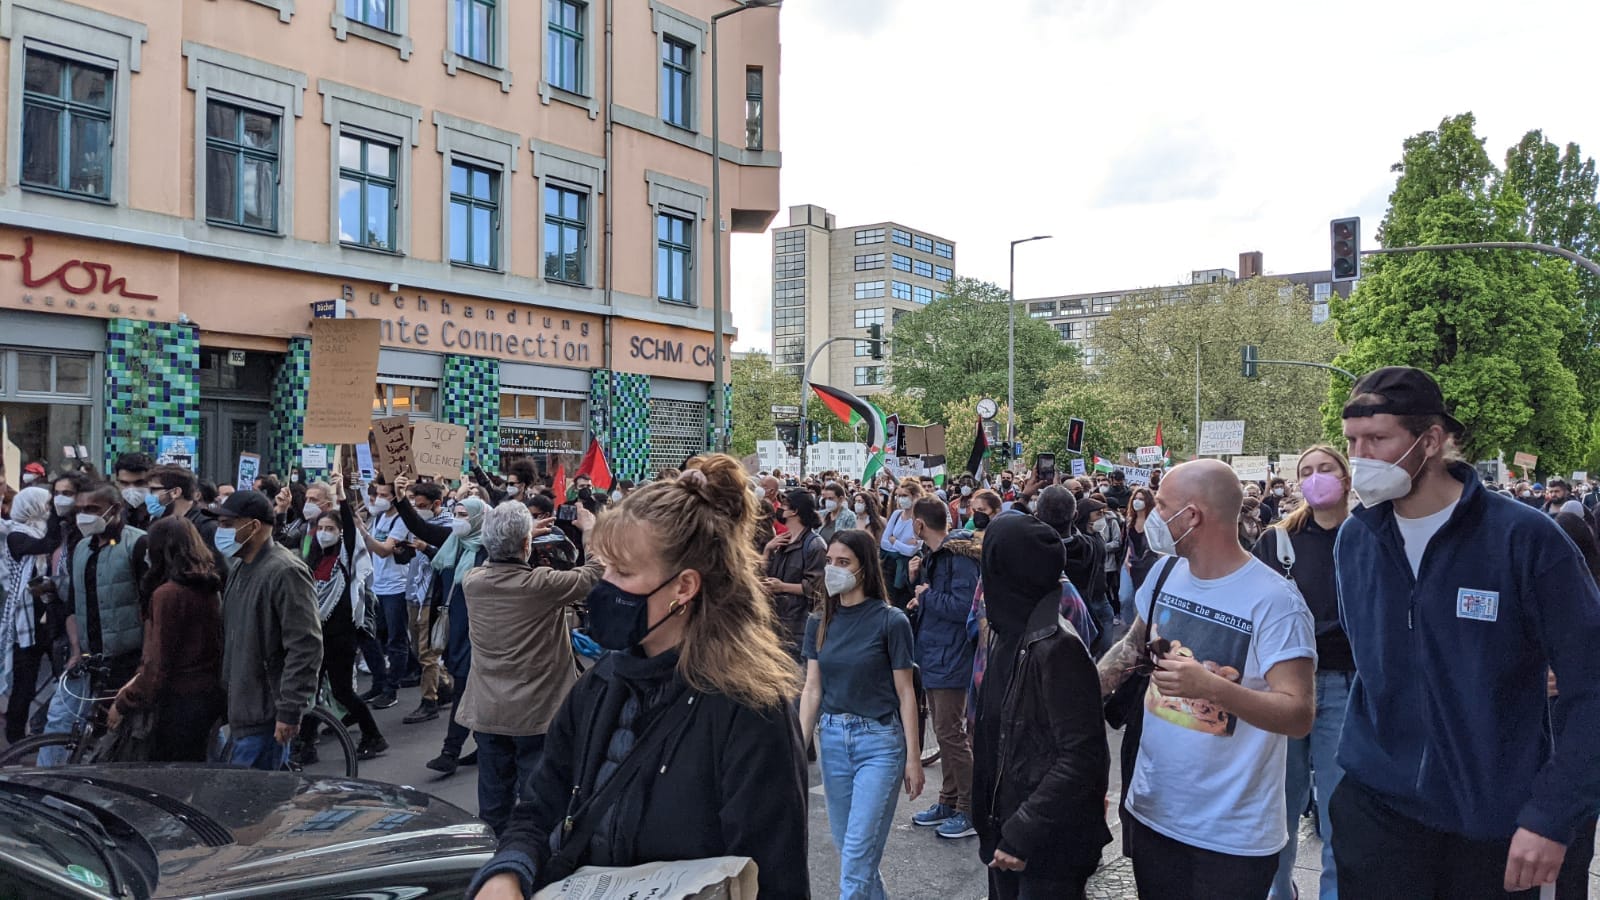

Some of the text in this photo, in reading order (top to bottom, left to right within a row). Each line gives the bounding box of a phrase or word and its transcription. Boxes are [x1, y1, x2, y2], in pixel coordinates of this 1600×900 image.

[343, 284, 590, 337] Buchhandlung
[442, 319, 590, 362] Connection
[424, 425, 458, 441] STOP
[523, 437, 572, 449] Connection
[415, 452, 460, 468] VIOLENCE
[1163, 595, 1252, 631] against the machine
